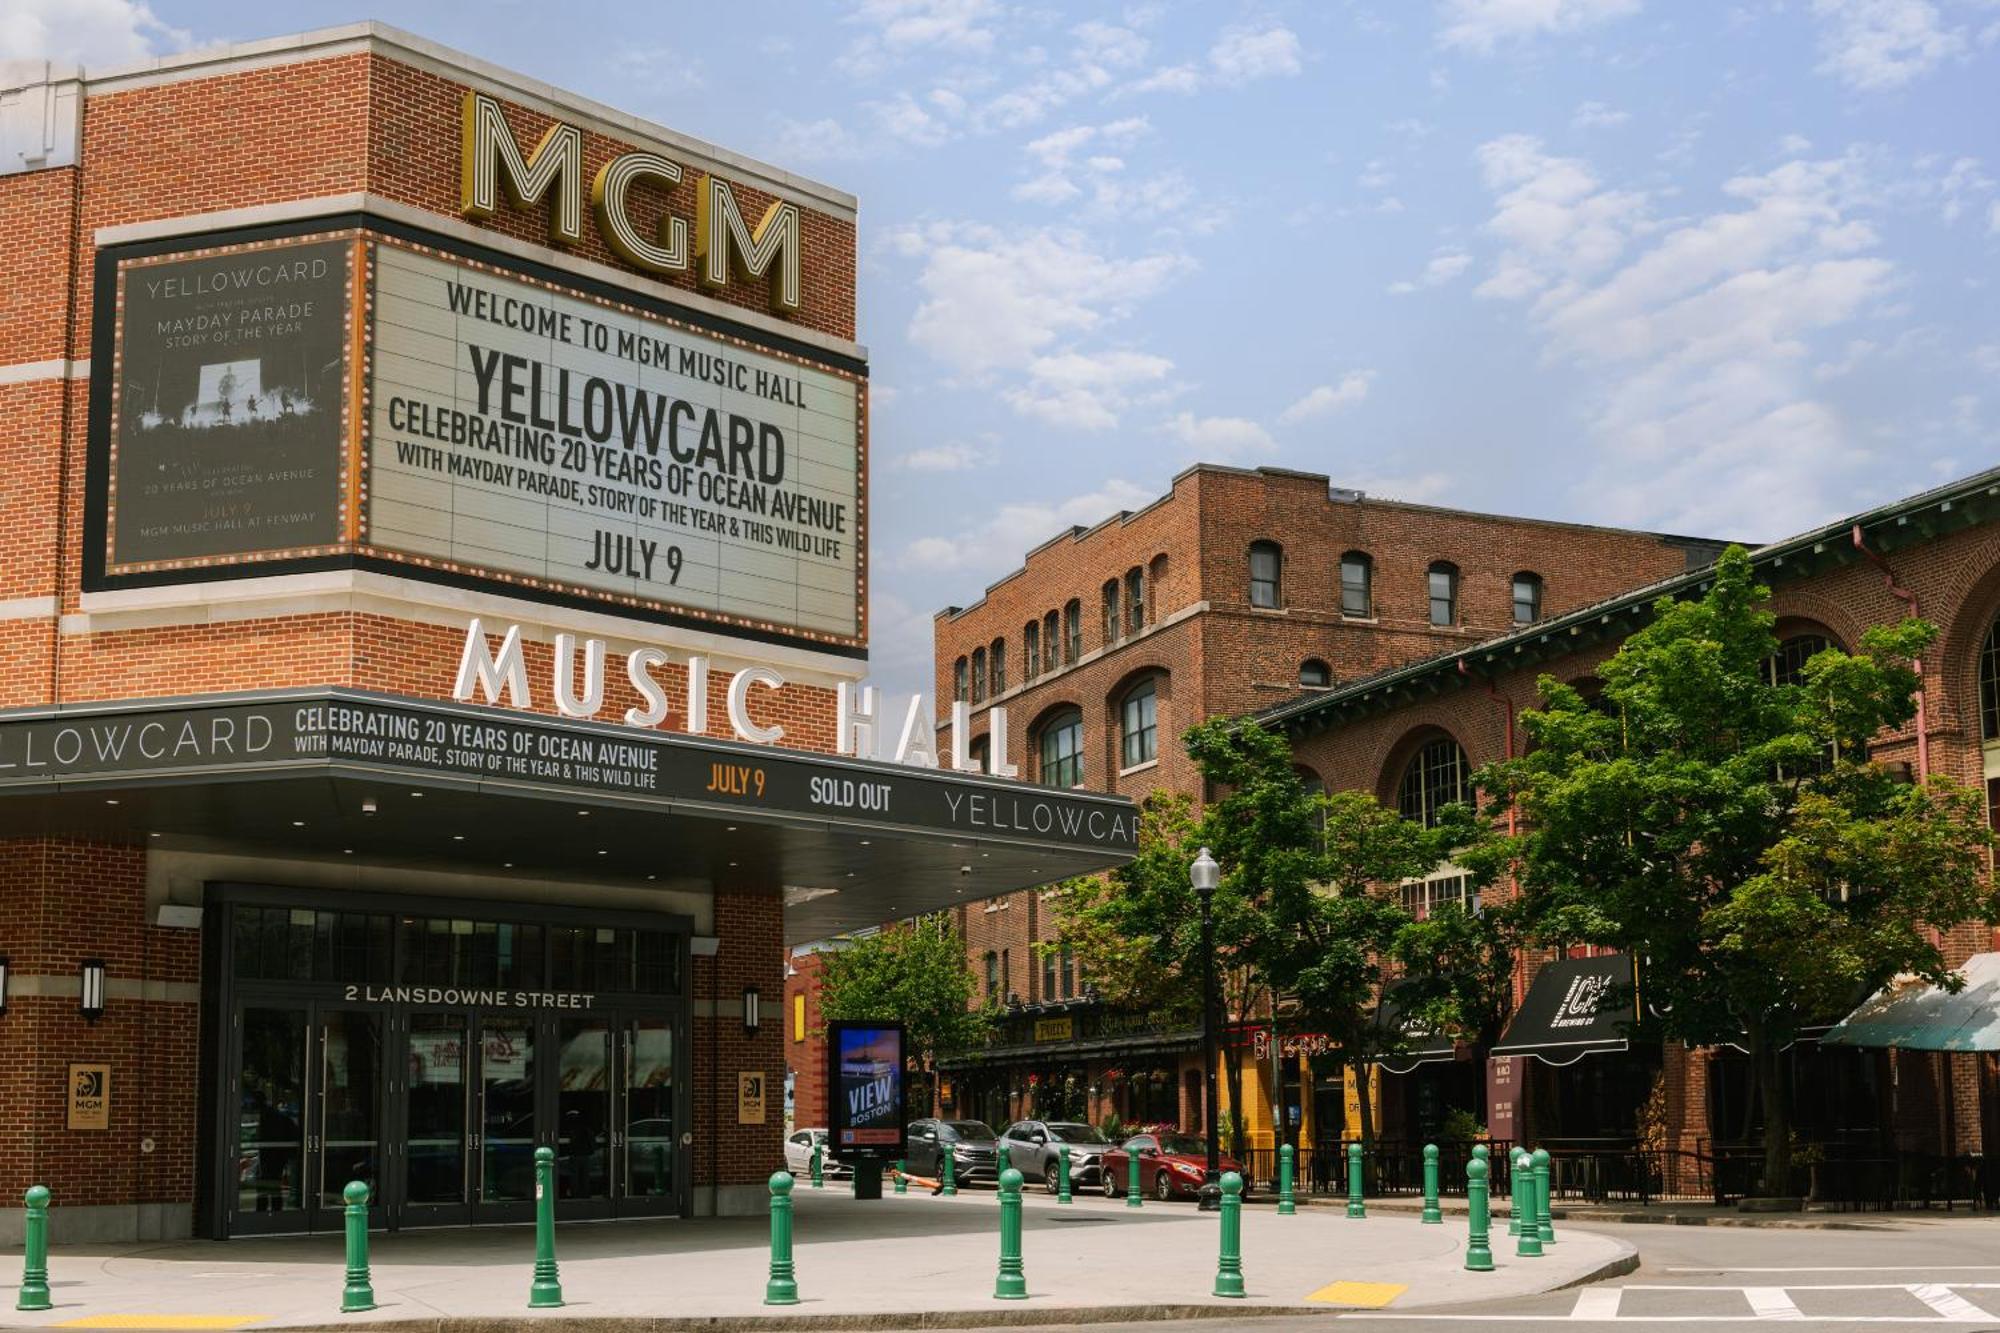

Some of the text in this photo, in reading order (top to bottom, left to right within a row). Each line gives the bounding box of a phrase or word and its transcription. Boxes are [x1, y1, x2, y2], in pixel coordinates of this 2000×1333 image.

[462, 91, 802, 311] MGM
[147, 259, 327, 299] YELLOWCARD
[157, 302, 314, 335] MAYDAY PARADE
[166, 334, 208, 350] STORY
[213, 330, 230, 344] OF
[237, 326, 262, 340] THE
[268, 321, 302, 336] YEAR
[447, 281, 806, 408] WELCOME TO MGM MUSIC HALL
[469, 344, 785, 485] YELLOWCARD
[162, 480, 197, 494] YEARS
[202, 477, 215, 489] OF
[223, 472, 262, 487] OCEAN
[267, 467, 316, 482] AVENUE
[389, 396, 846, 534] CELEBRATING 20 YEARS OF OCEAN AVENUE
[203, 503, 236, 520] JULY
[396, 440, 841, 560] WITH MAYDAY PARADE, STORY OF THE YEAR & THIS WILD LIFE
[140, 526, 168, 538] MGM
[173, 521, 210, 534] MUSIC
[267, 511, 316, 525] FENWAY
[585, 529, 682, 585] JULY 9
[452, 618, 784, 744] MUSIC
[295, 707, 658, 771] CELEBRATING 20 YEARS OF OCEAN AVENUE
[837, 681, 1018, 777] HALL
[294, 735, 656, 789] WITH MAYDAY PARADE, STORY OF THE YEAR & THIS WILD LIFE
[707, 763, 765, 797] JULY 9
[810, 776, 891, 811] SOLD OUT
[345, 985, 595, 1009] 2 LANSDOWNE STREET
[75, 1100, 102, 1110] MGM
[848, 1076, 891, 1115] VIEW
[850, 1102, 892, 1127] BOSTON
